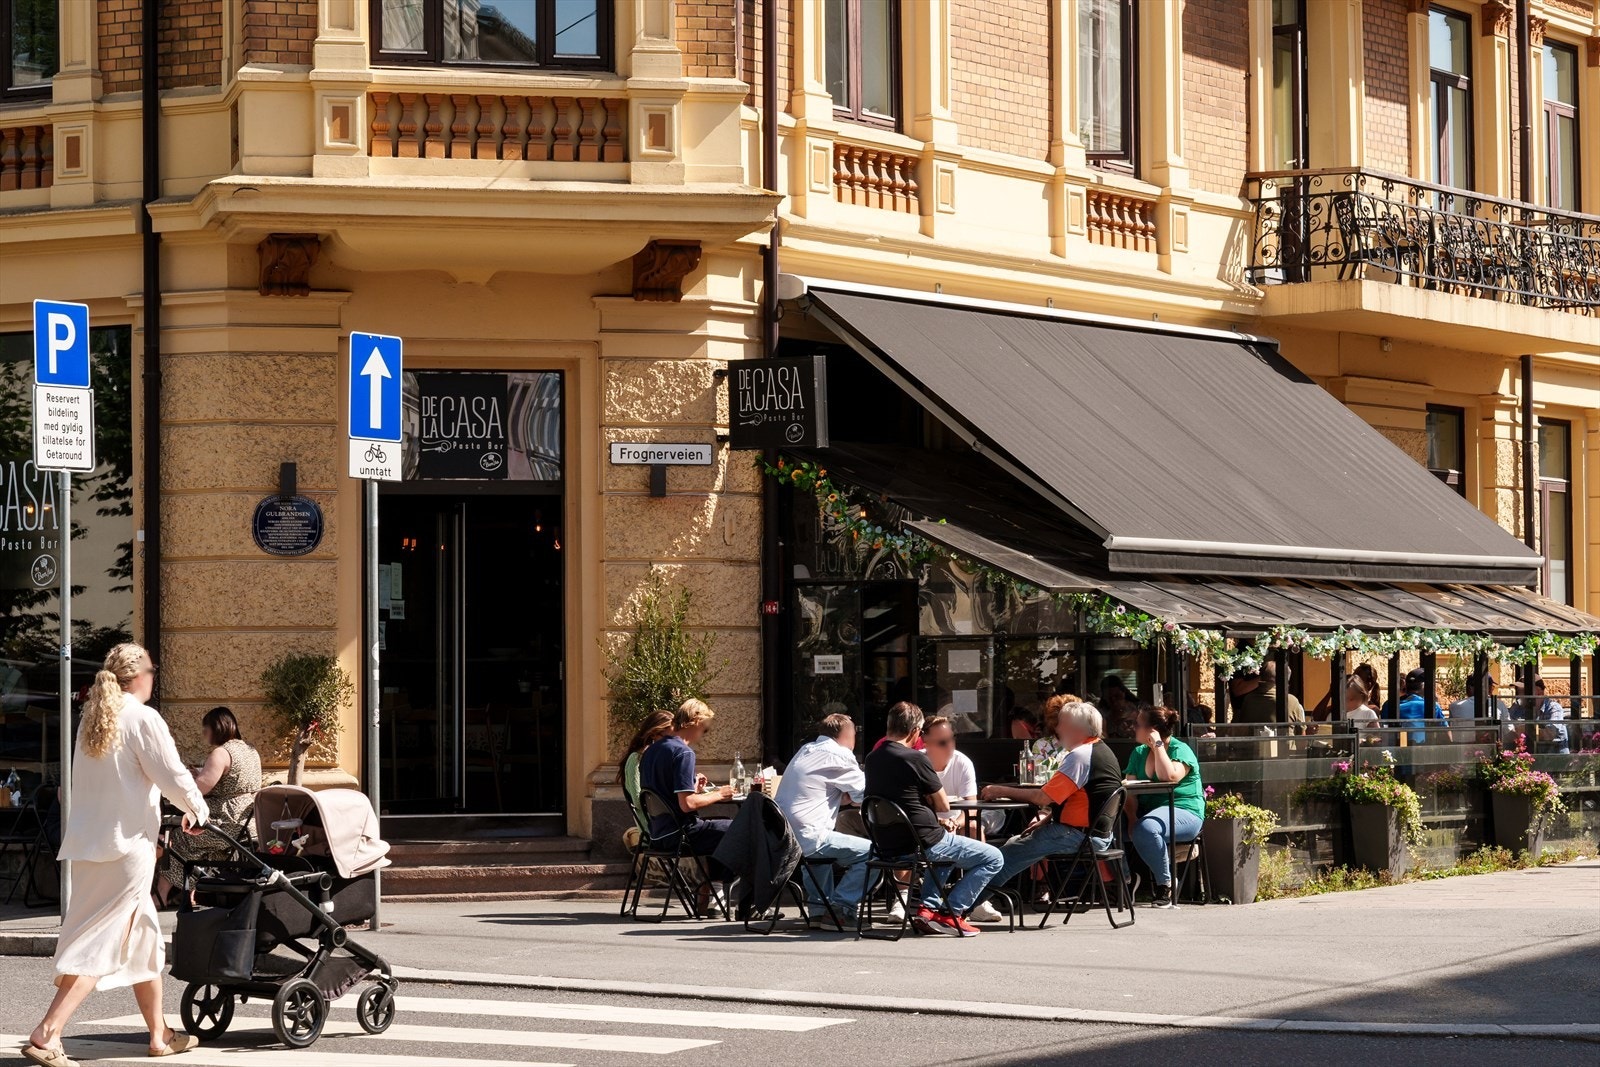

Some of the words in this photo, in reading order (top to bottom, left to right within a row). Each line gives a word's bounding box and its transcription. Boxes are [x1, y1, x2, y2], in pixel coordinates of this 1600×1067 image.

[47, 312, 76, 374] P
[738, 368, 751, 390] DE
[752, 366, 805, 411] CASA
[46, 393, 80, 404] Reservert
[739, 391, 752, 412] LA
[48, 408, 79, 420] bildeling
[421, 396, 438, 417] DE
[440, 396, 504, 439] CASA
[44, 422, 59, 431] med
[61, 423, 83, 434] gyldig
[422, 418, 439, 439] LA
[42, 436, 73, 446] tillatelse
[75, 437, 86, 447] for
[452, 441, 481, 450] Pasta
[487, 441, 504, 450] Bar
[46, 449, 82, 460] Getaround
[620, 447, 703, 462] Frognerveien
[359, 467, 392, 477] unntatt
[0, 460, 58, 531] ASA
[1, 537, 32, 551] Pasta
[40, 536, 58, 550] Bar
